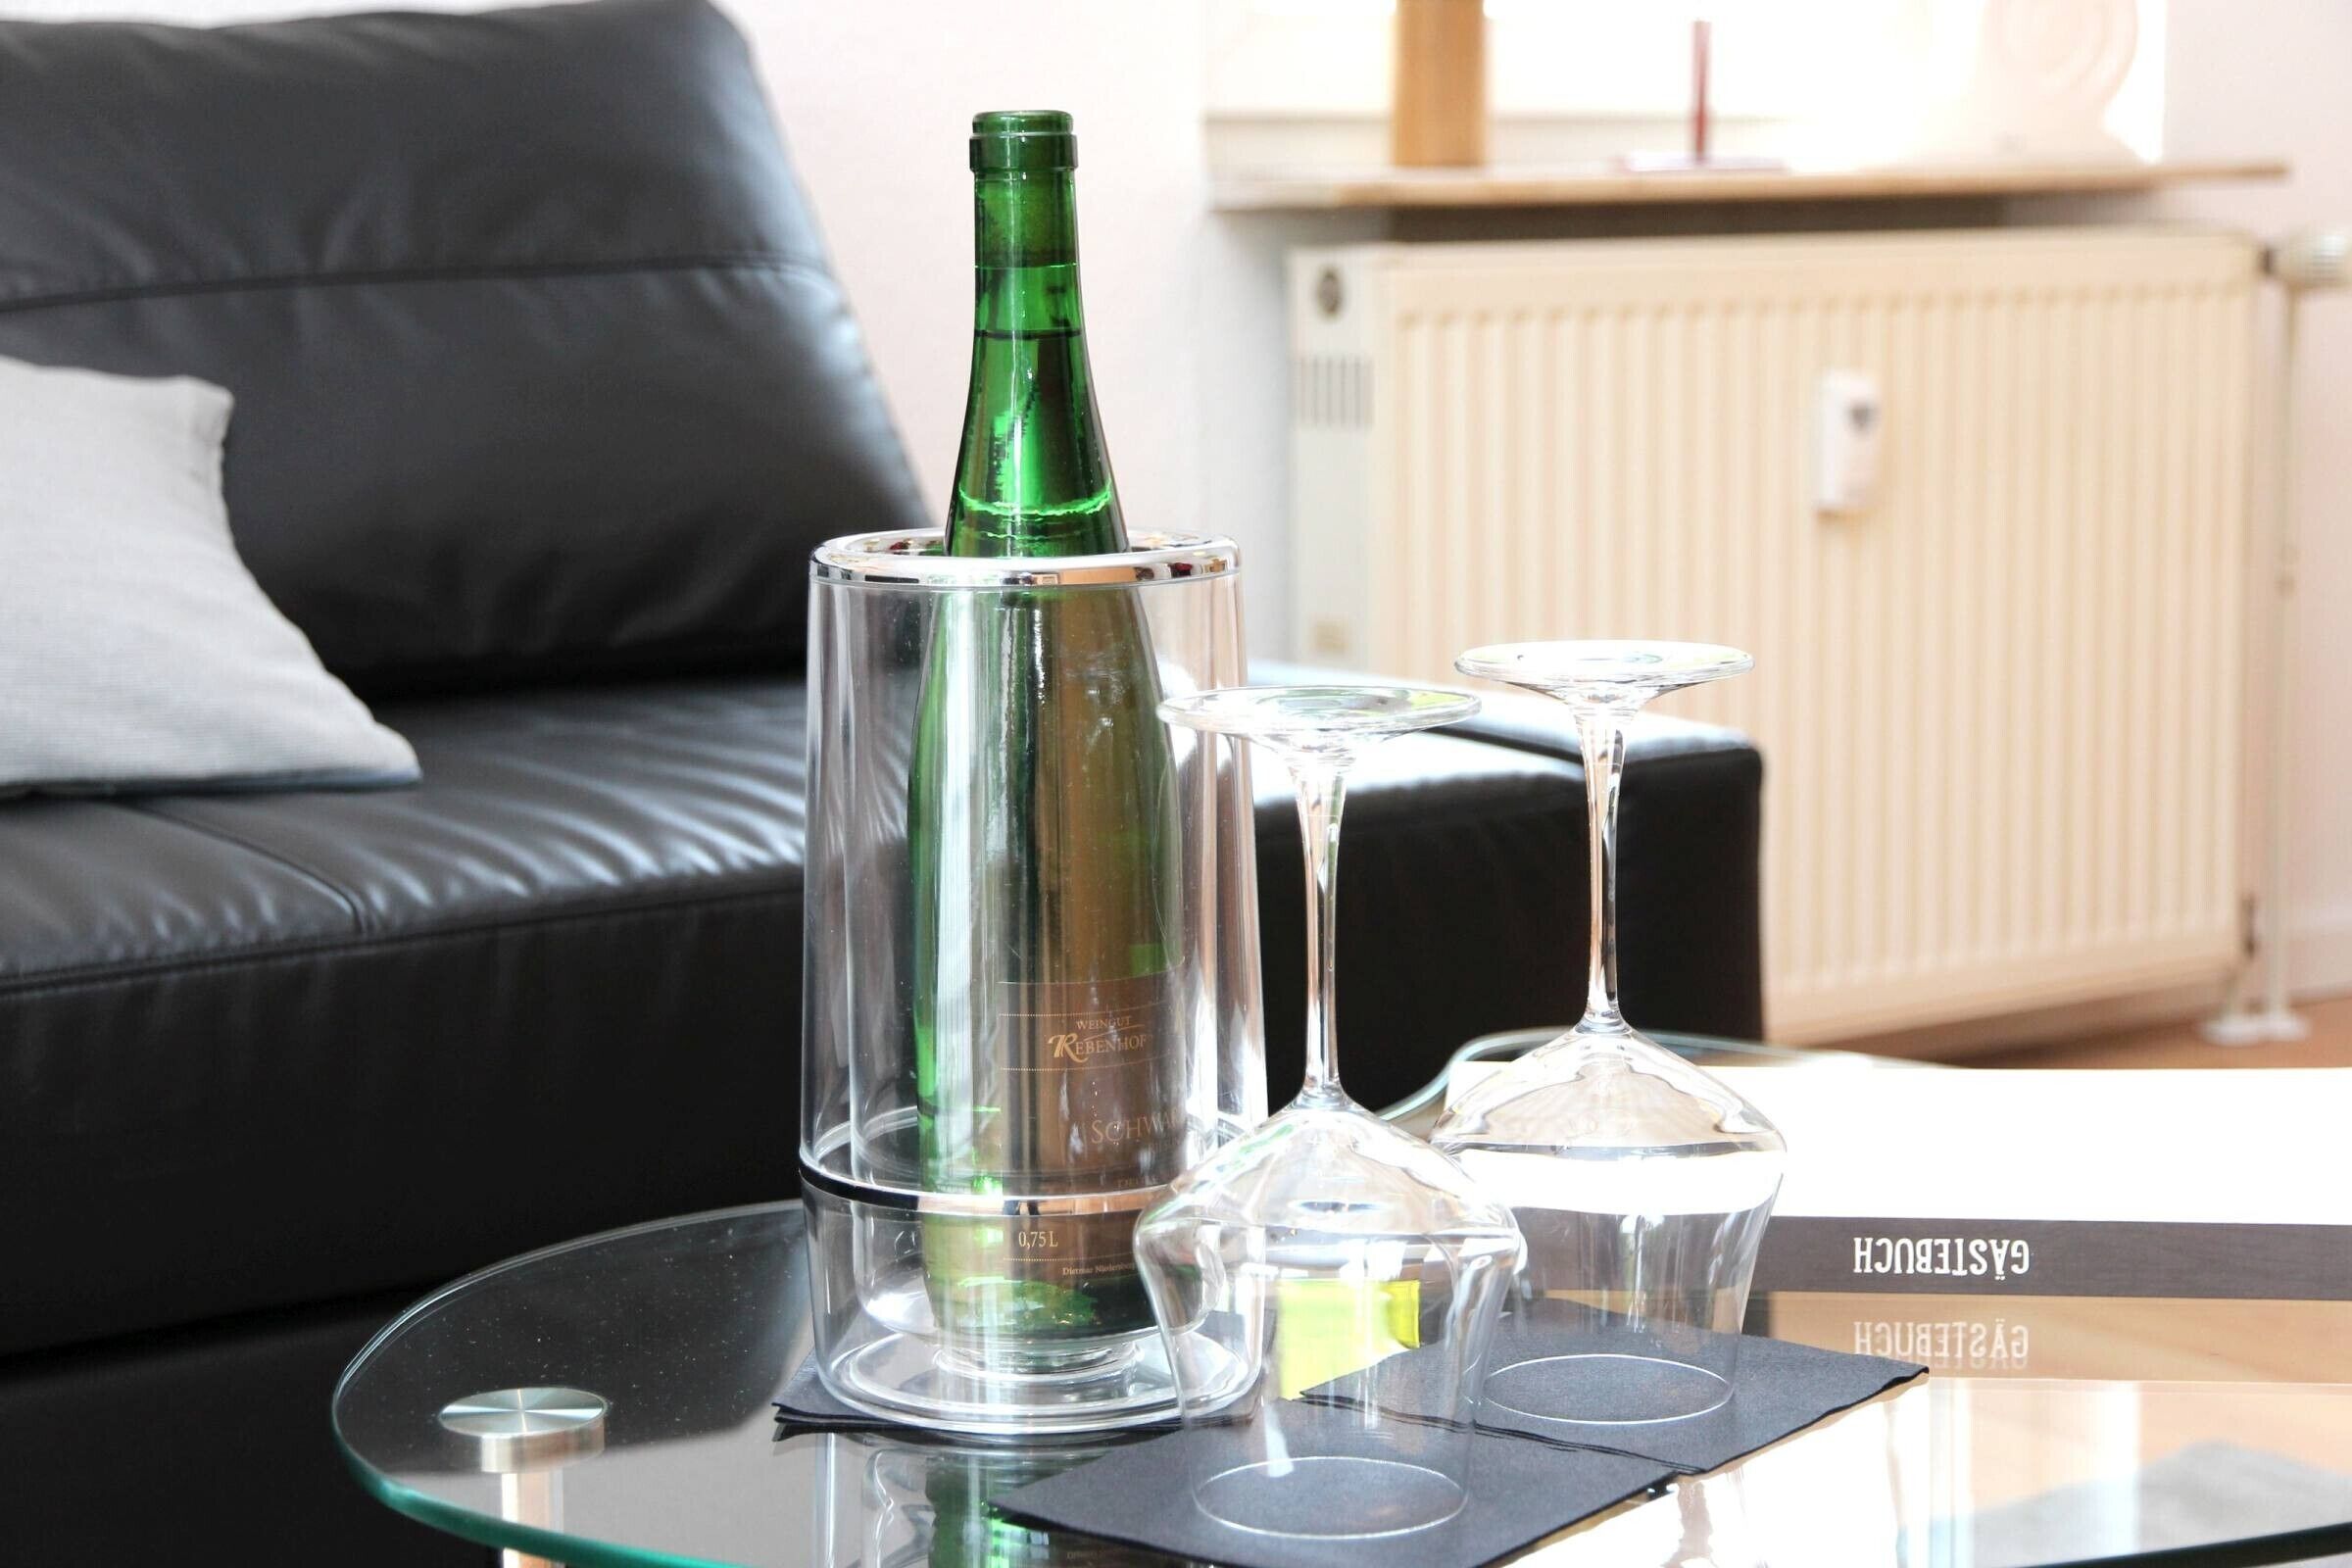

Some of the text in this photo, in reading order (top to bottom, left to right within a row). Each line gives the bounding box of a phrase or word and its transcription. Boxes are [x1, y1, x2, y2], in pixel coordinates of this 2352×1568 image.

[1076, 1015, 1132, 1030] WEINGUT
[1018, 1230, 1058, 1250] 0,75 L
[1853, 1237, 2030, 1281] GÄSTEBUCH
